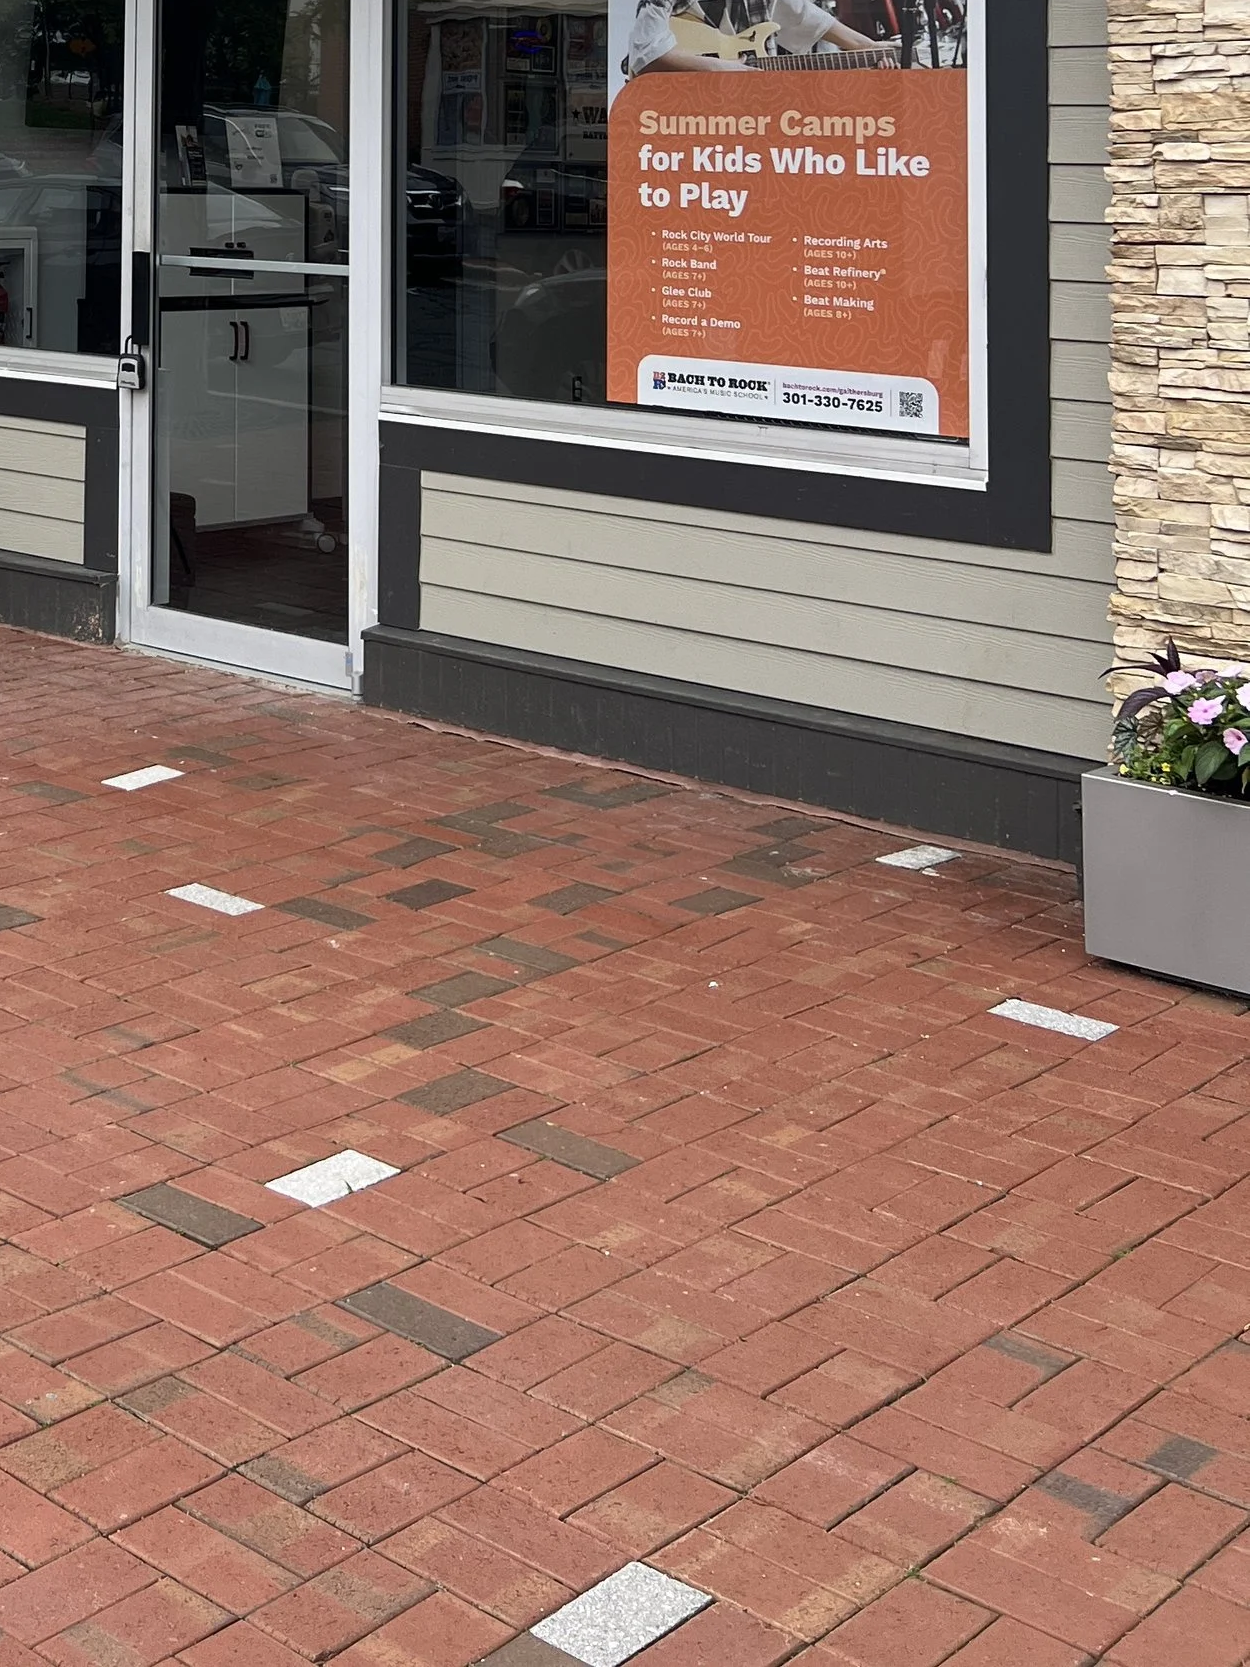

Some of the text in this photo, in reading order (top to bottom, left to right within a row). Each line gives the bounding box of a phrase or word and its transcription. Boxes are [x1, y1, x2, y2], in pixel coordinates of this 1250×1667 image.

[639, 109, 896, 144] Summer Camps
[639, 144, 931, 177] for Kids Who Like
[639, 182, 749, 218] to Play
[662, 229, 773, 243] Rock City World Tour
[804, 235, 888, 250] Recording Arts
[662, 242, 689, 252] (AGES
[803, 249, 857, 260] (AGES 10+)
[662, 258, 717, 270] Rock Band
[804, 265, 829, 276] Beat
[662, 270, 706, 282] (AGES 7+)
[803, 278, 857, 290] (AGES 10+)
[662, 286, 712, 298] Glee Club
[662, 298, 706, 310] (AGES 7+)
[804, 295, 875, 311] Beat Making
[803, 308, 852, 320] (AGES 8+)
[662, 314, 698, 326] Record
[710, 317, 741, 329] Demo
[662, 326, 706, 339] (AGES 7+)
[667, 372, 768, 392] BACH TO ROCK
[672, 385, 763, 400] AMERICA'S MUSIC SCHOOL
[782, 392, 883, 412] 301-330-7625
